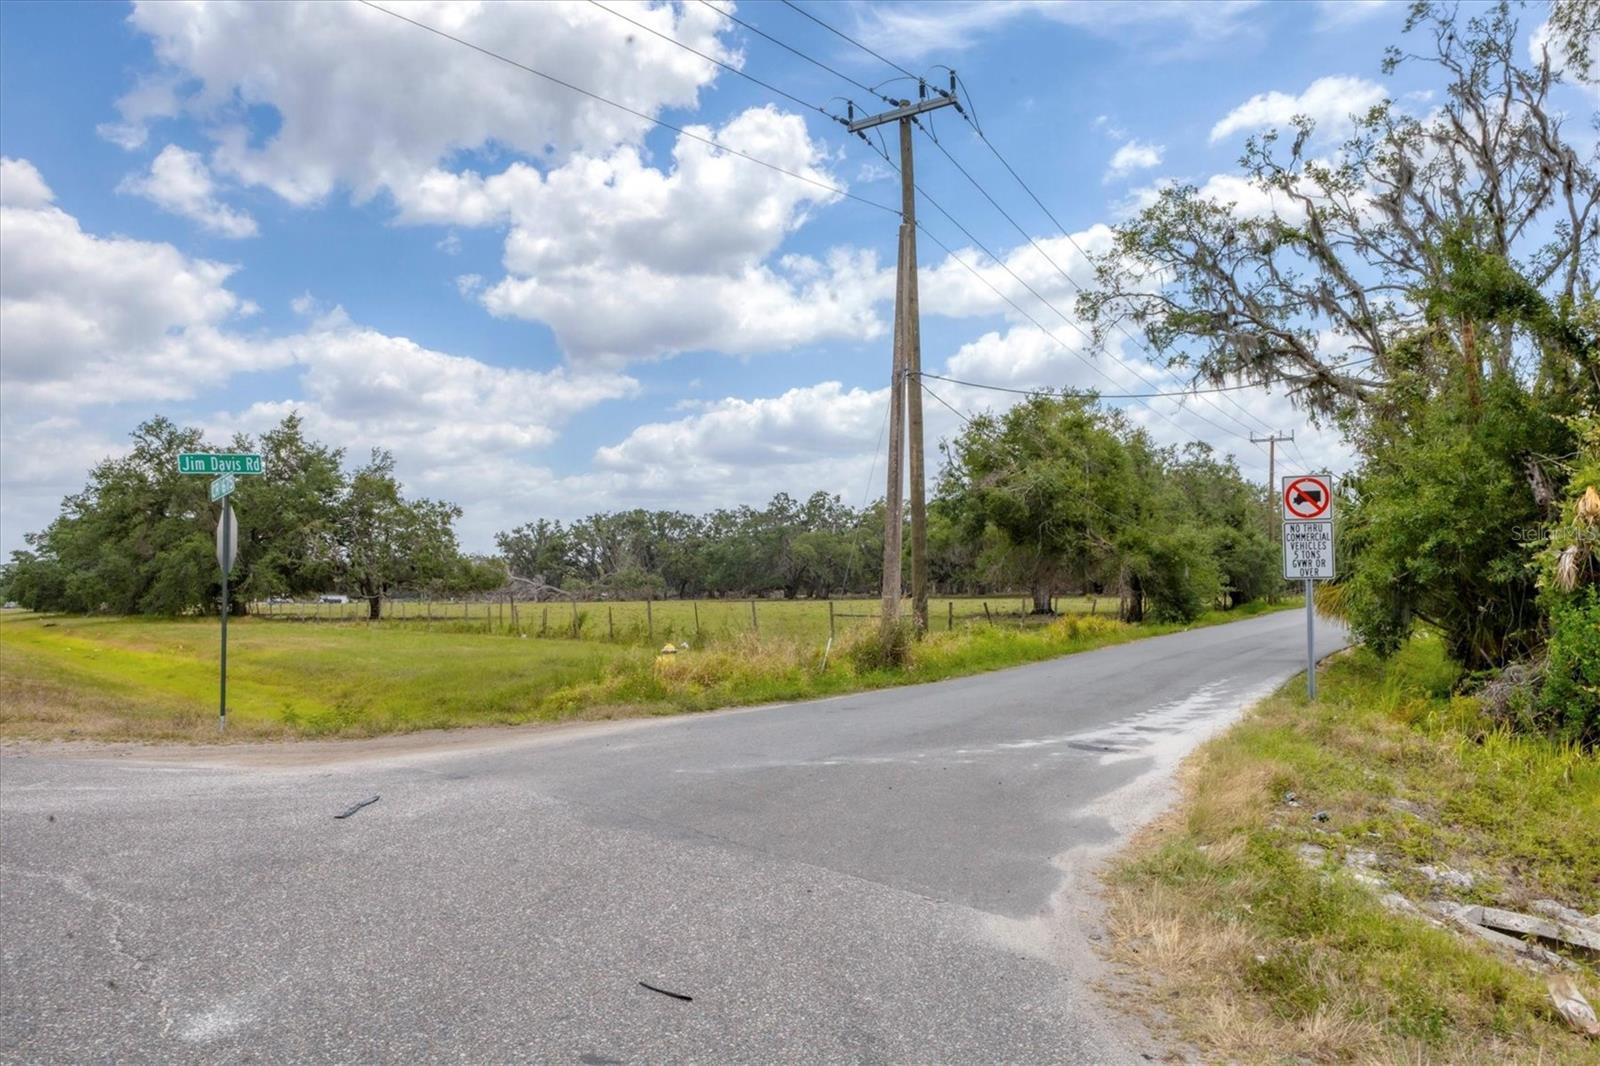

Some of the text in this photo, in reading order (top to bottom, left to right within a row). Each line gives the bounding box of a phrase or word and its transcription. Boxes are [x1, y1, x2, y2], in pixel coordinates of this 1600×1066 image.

[182, 456, 260, 471] Jim Davis Rd
[1290, 524, 1323, 533] NO THRU
[1286, 533, 1330, 541] COMMERCIAL
[1290, 542, 1327, 550] VEHICLES
[1294, 551, 1321, 559] 5 TONS
[1292, 559, 1326, 567] GVWR OR
[1299, 568, 1319, 577] OVER
